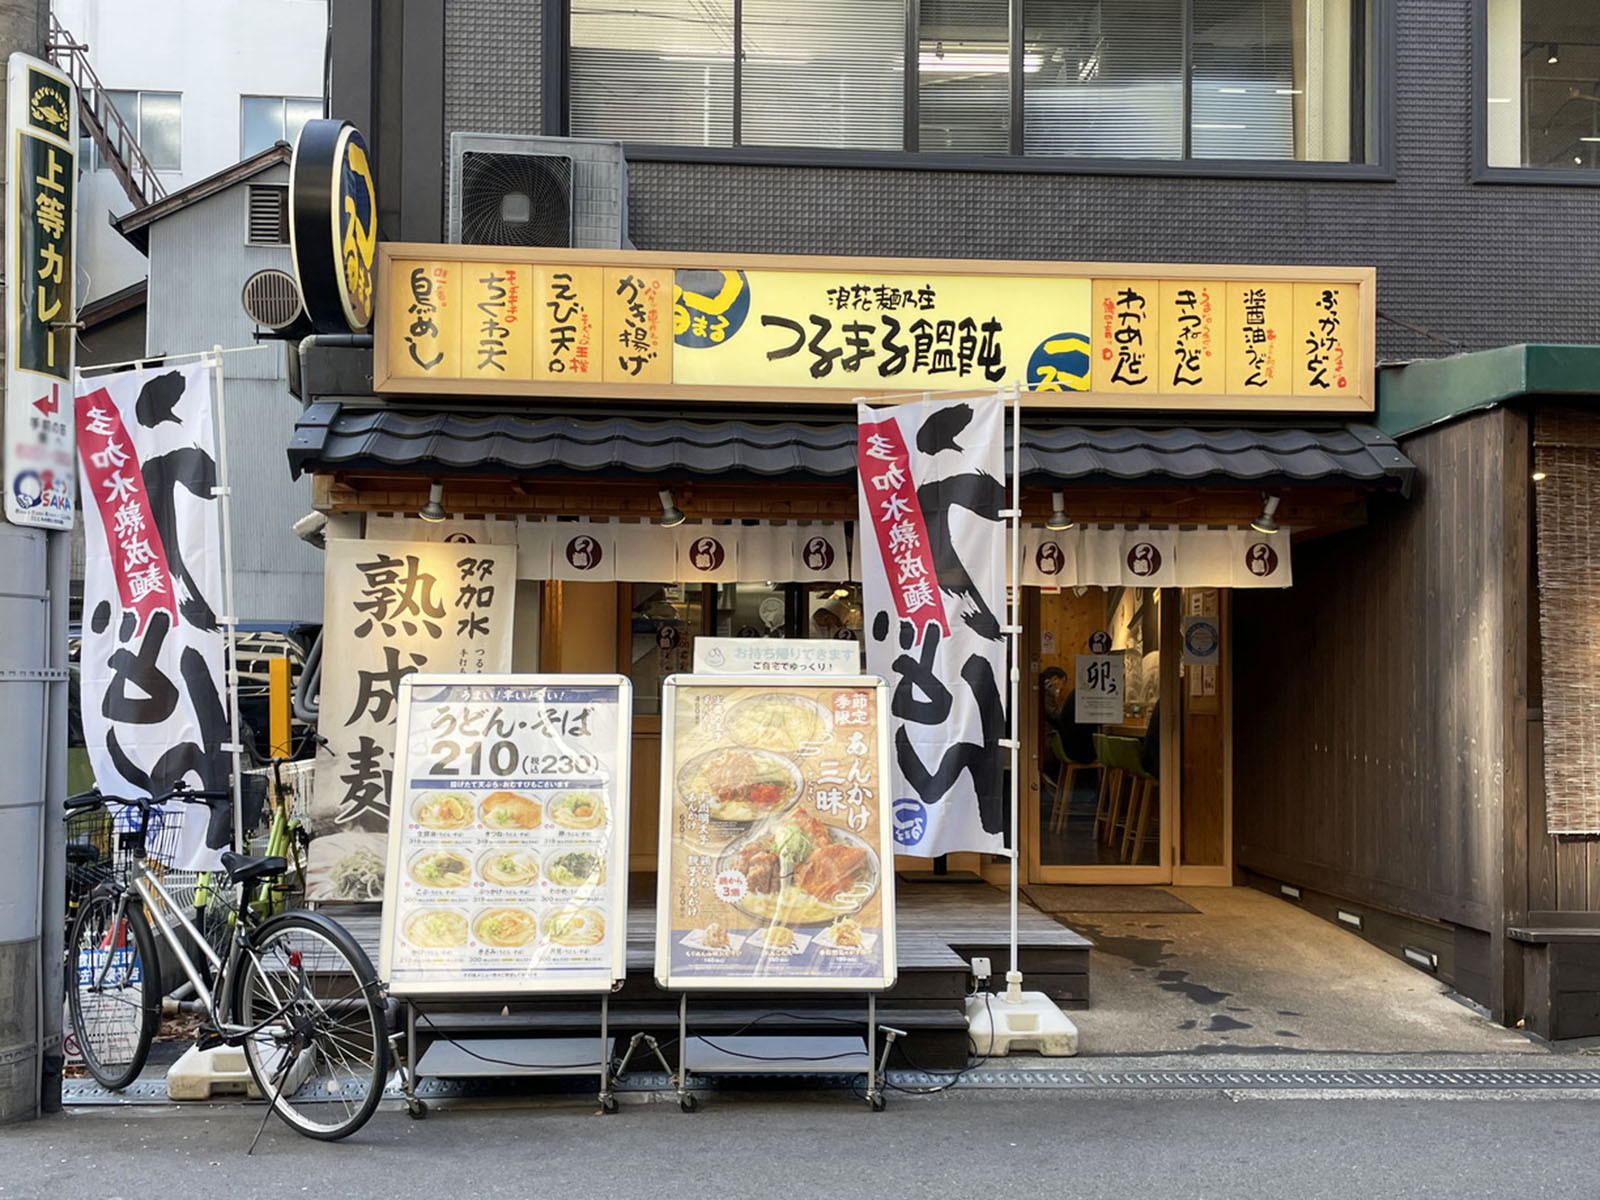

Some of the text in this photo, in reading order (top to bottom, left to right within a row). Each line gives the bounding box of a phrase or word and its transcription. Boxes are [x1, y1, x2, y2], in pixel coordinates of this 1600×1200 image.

[36, 149, 64, 367] 上等カレー
[404, 268, 443, 370] 鳥めし
[477, 273, 510, 371] ちくわ天
[617, 275, 657, 376] かき揚げ
[761, 314, 1006, 382] つるまる饂飩
[1111, 288, 1148, 385] わかめうどん
[1173, 290, 1203, 386] きつねうどん
[734, 647, 855, 662] お持ち帰りできます
[429, 741, 519, 777] 210
[431, 706, 595, 739] うどん・そば
[847, 731, 873, 832] あんかけ
